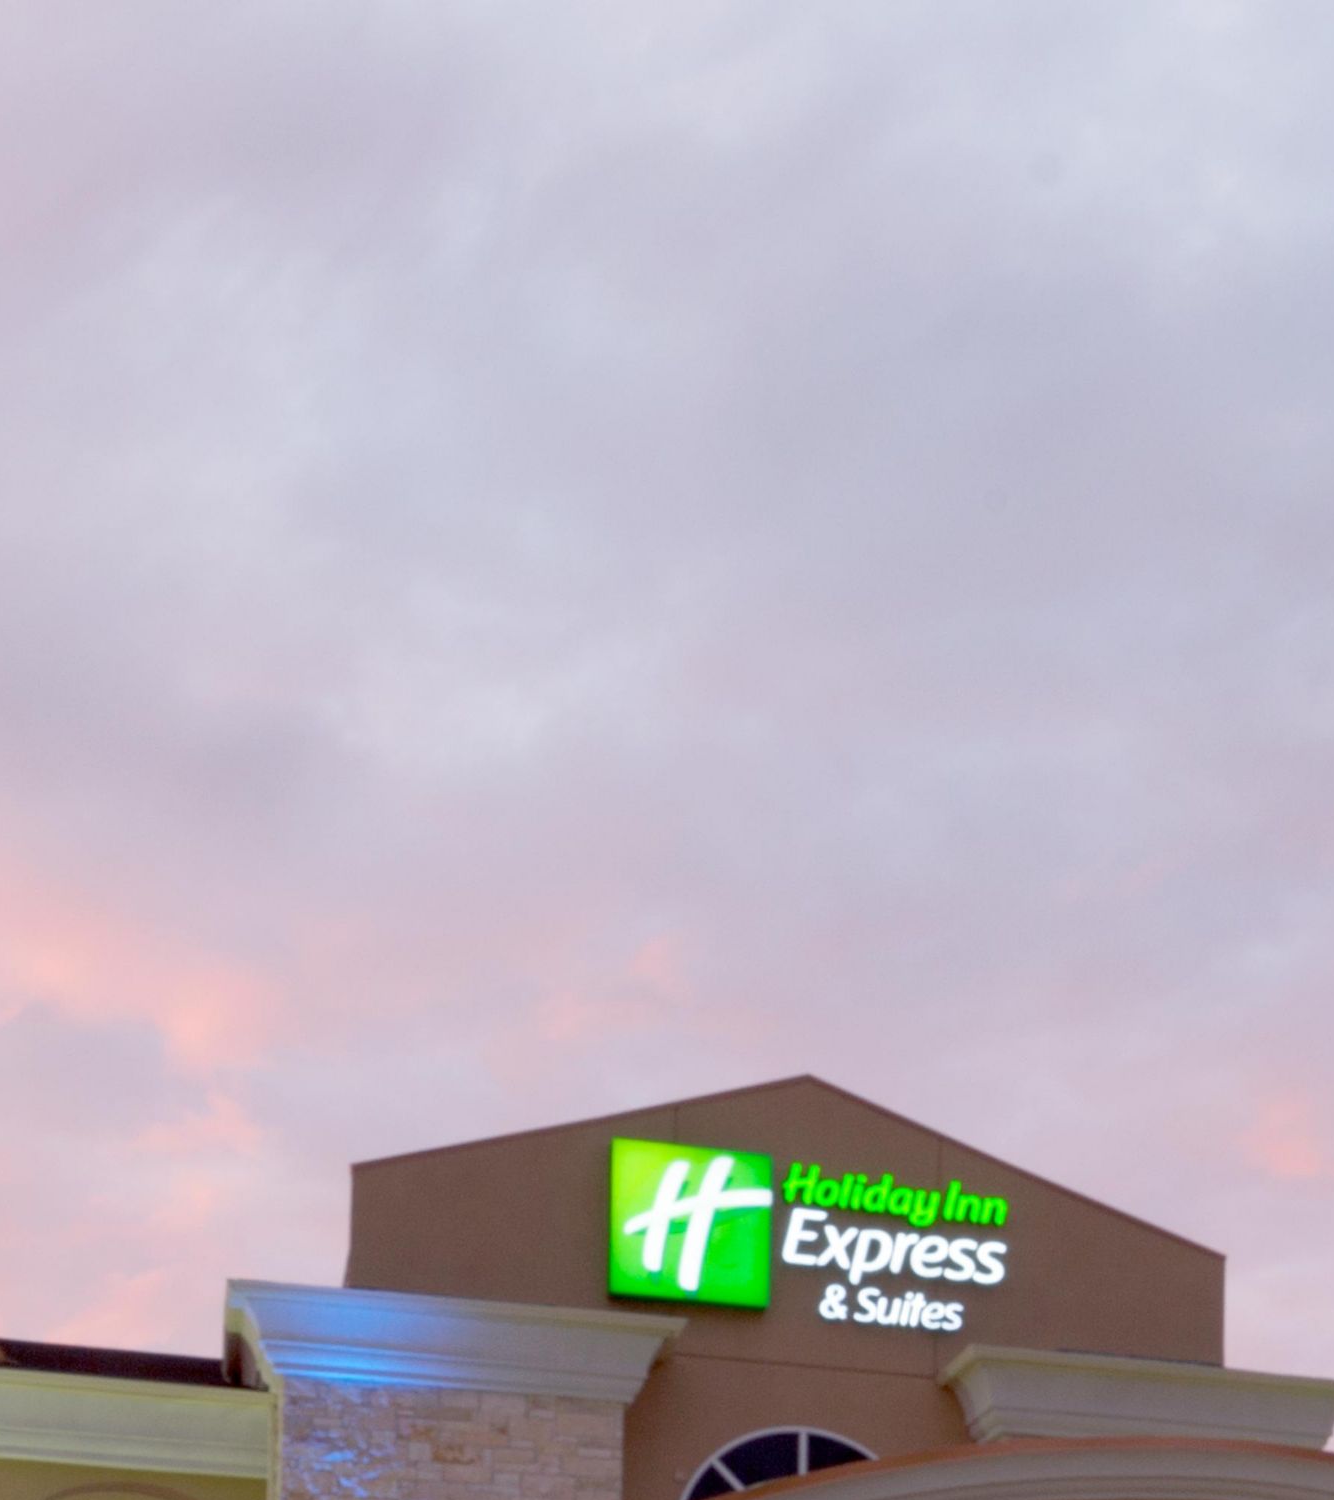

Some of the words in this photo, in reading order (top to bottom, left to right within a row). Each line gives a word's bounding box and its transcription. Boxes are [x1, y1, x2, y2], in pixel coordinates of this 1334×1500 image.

[783, 1162, 941, 1228] Holiday
[942, 1180, 1008, 1226] Inn
[781, 1206, 1008, 1286] Express
[818, 1283, 848, 1321] &
[853, 1285, 965, 1331] Suites
